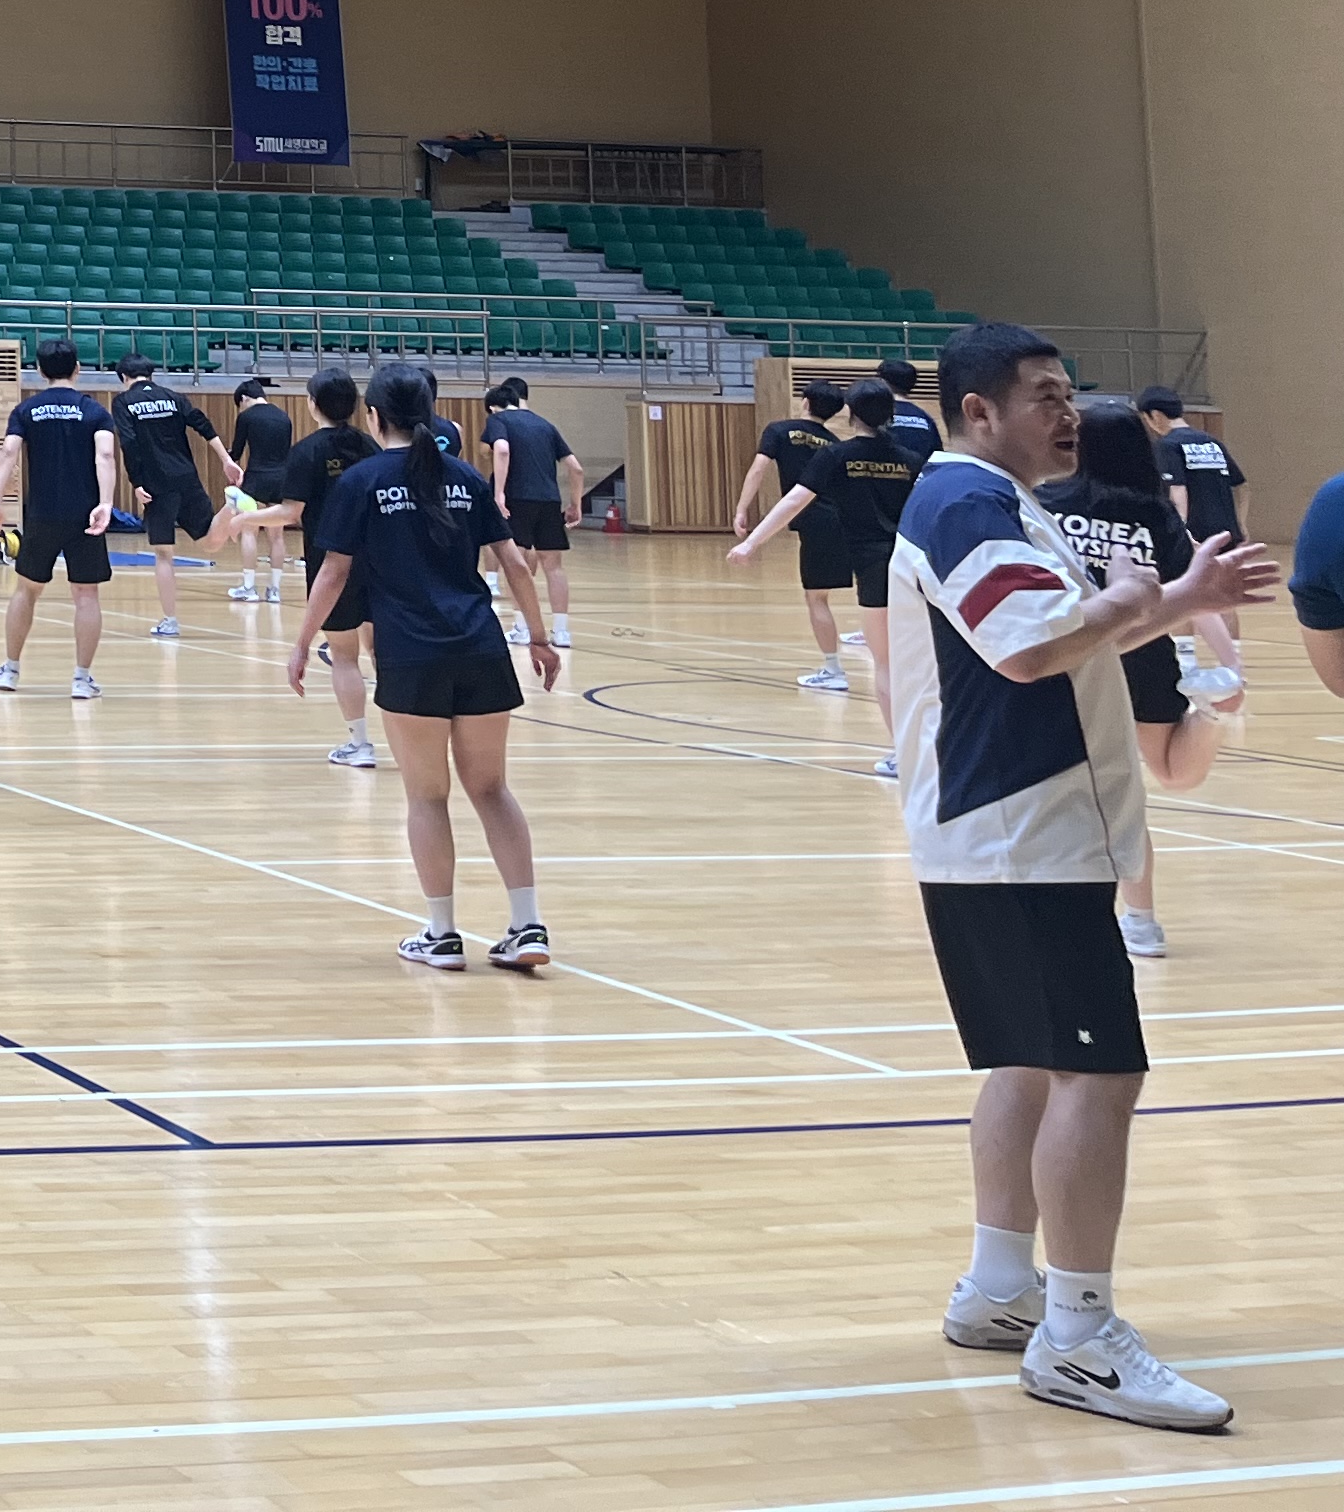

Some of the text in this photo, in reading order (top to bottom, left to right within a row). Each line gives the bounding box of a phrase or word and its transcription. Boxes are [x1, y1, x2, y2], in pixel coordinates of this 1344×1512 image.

[265, 24, 302, 46] 합격
[256, 136, 283, 153] SMU
[31, 405, 83, 416] POTENTIAL
[128, 399, 178, 416] POTENTIAL
[846, 460, 910, 473] POTENTIAL
